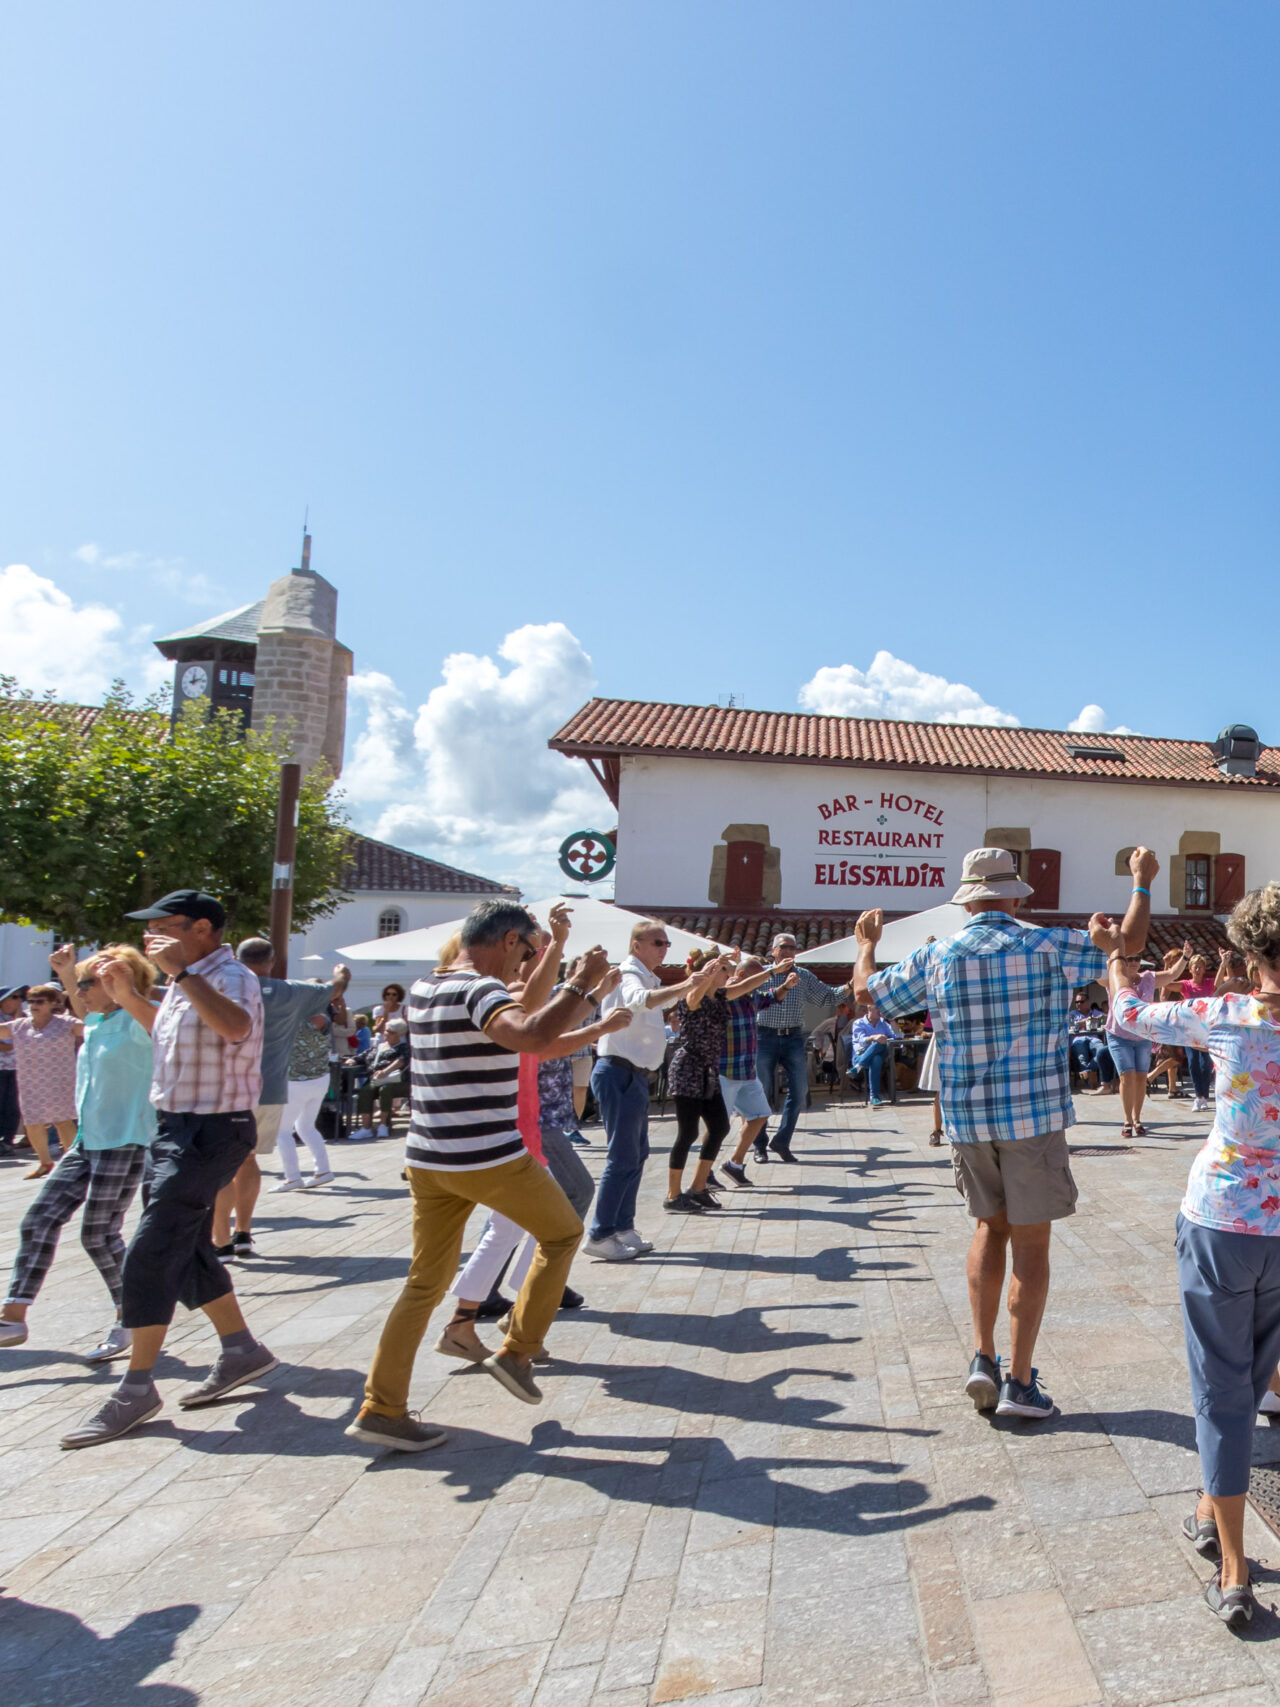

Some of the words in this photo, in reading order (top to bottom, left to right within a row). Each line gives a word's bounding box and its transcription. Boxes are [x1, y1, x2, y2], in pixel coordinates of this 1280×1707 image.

[818, 795, 860, 820] BAR
[880, 792, 944, 826] HOTEL
[818, 829, 944, 848] RESTAURANT
